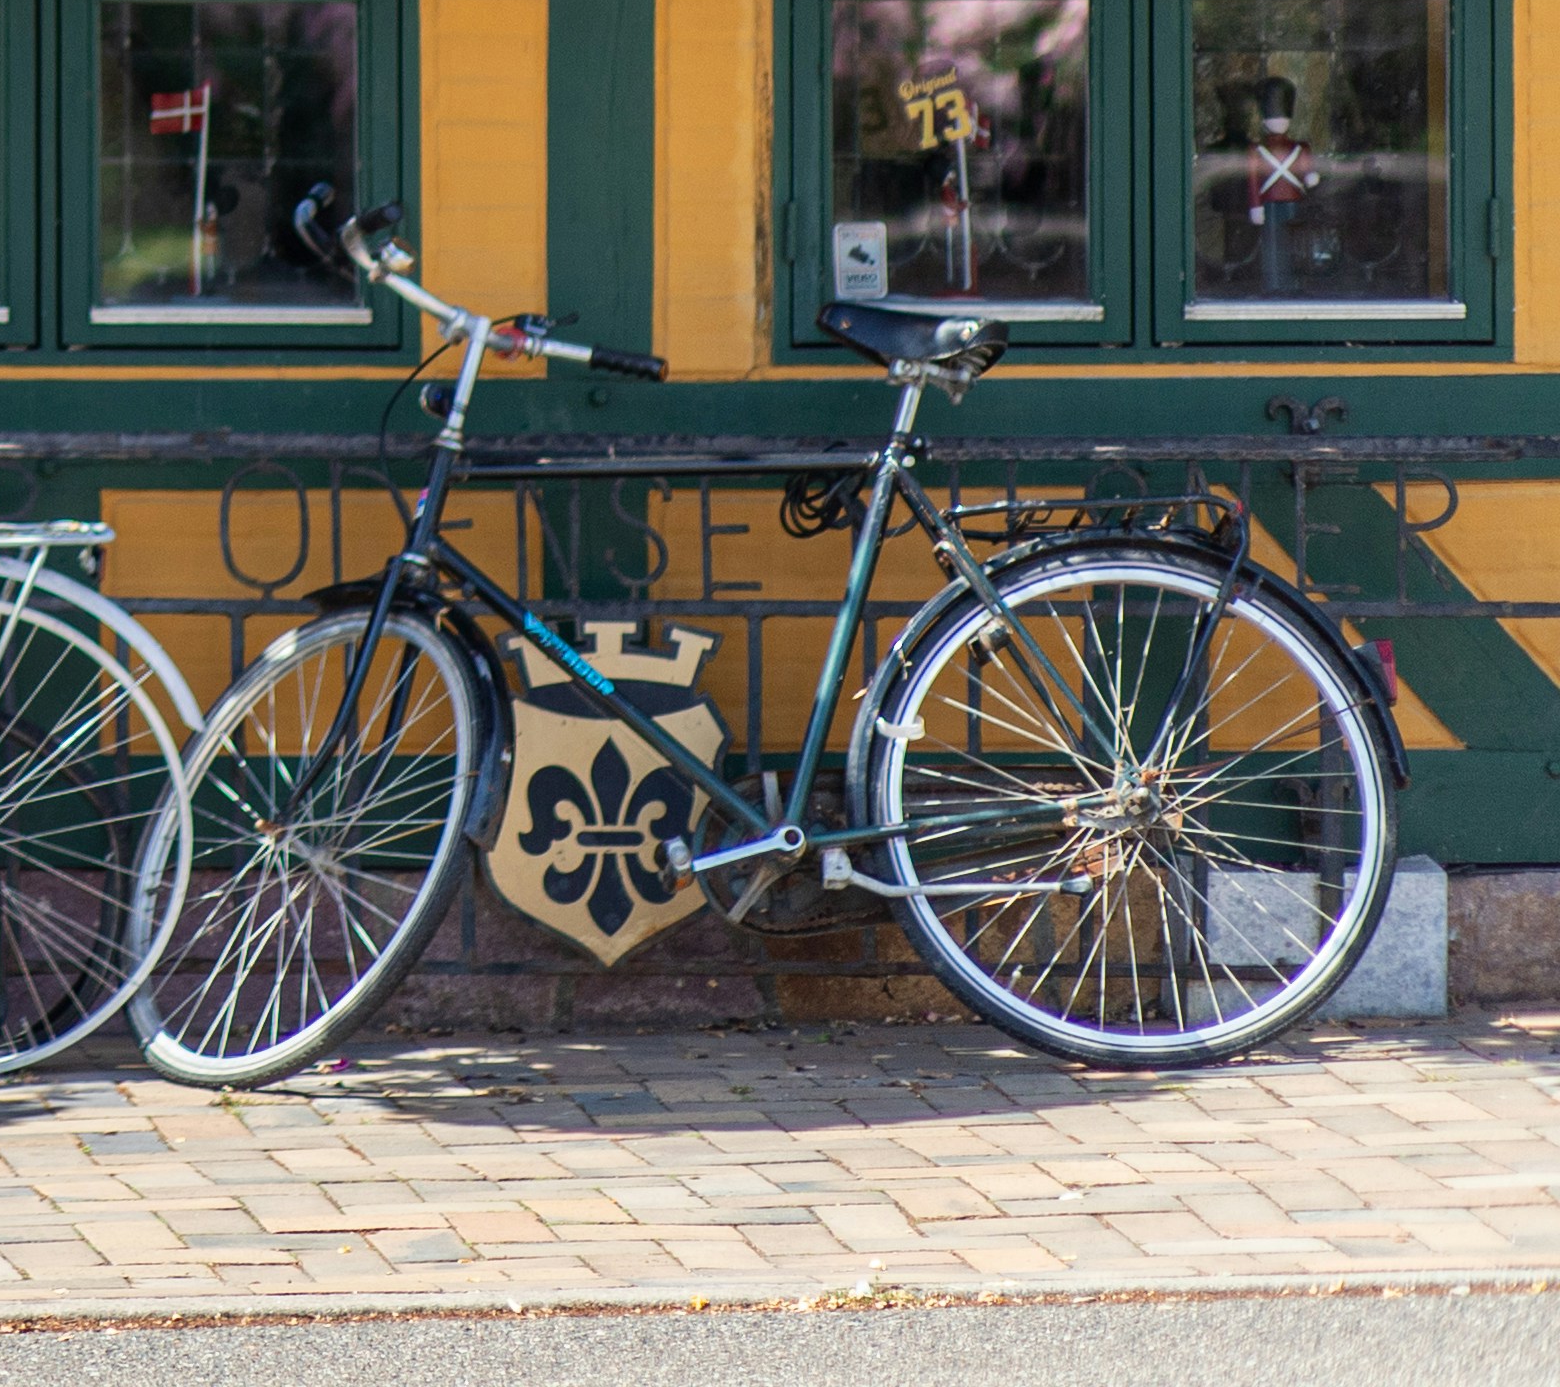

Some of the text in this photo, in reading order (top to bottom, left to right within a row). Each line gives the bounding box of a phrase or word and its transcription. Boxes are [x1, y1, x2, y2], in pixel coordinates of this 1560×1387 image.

[899, 66, 958, 101] Original
[905, 89, 973, 149] 73
[220, 459, 763, 602] ODNSE
